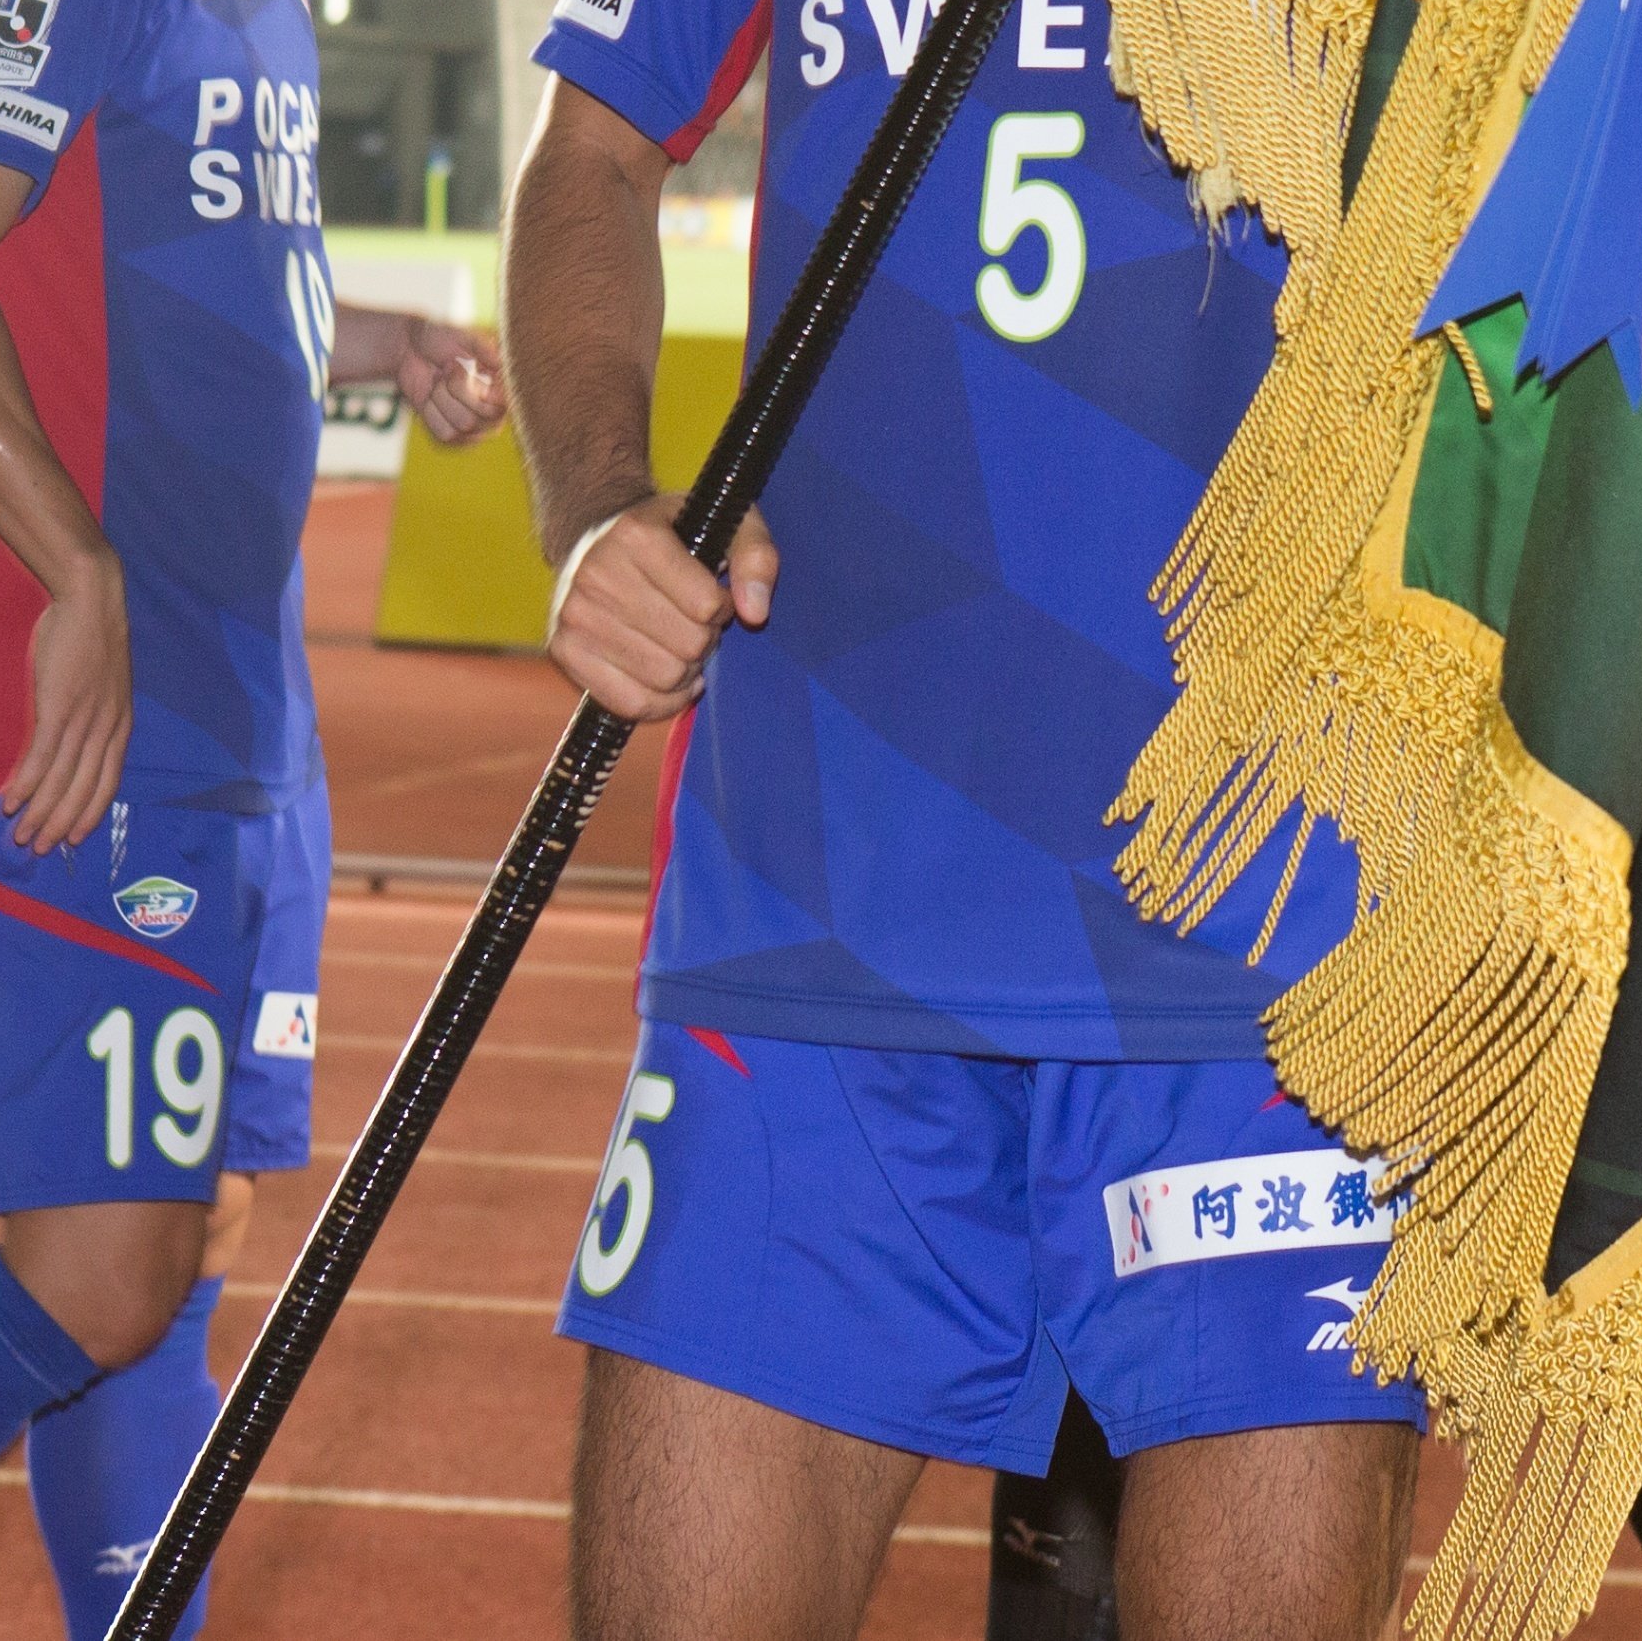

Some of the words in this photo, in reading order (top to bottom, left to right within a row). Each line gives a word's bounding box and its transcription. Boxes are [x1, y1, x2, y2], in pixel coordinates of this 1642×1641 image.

[189, 149, 322, 228] SWE
[975, 110, 1086, 344] 5
[86, 1006, 226, 1170] 19
[577, 1071, 675, 1298] 5
